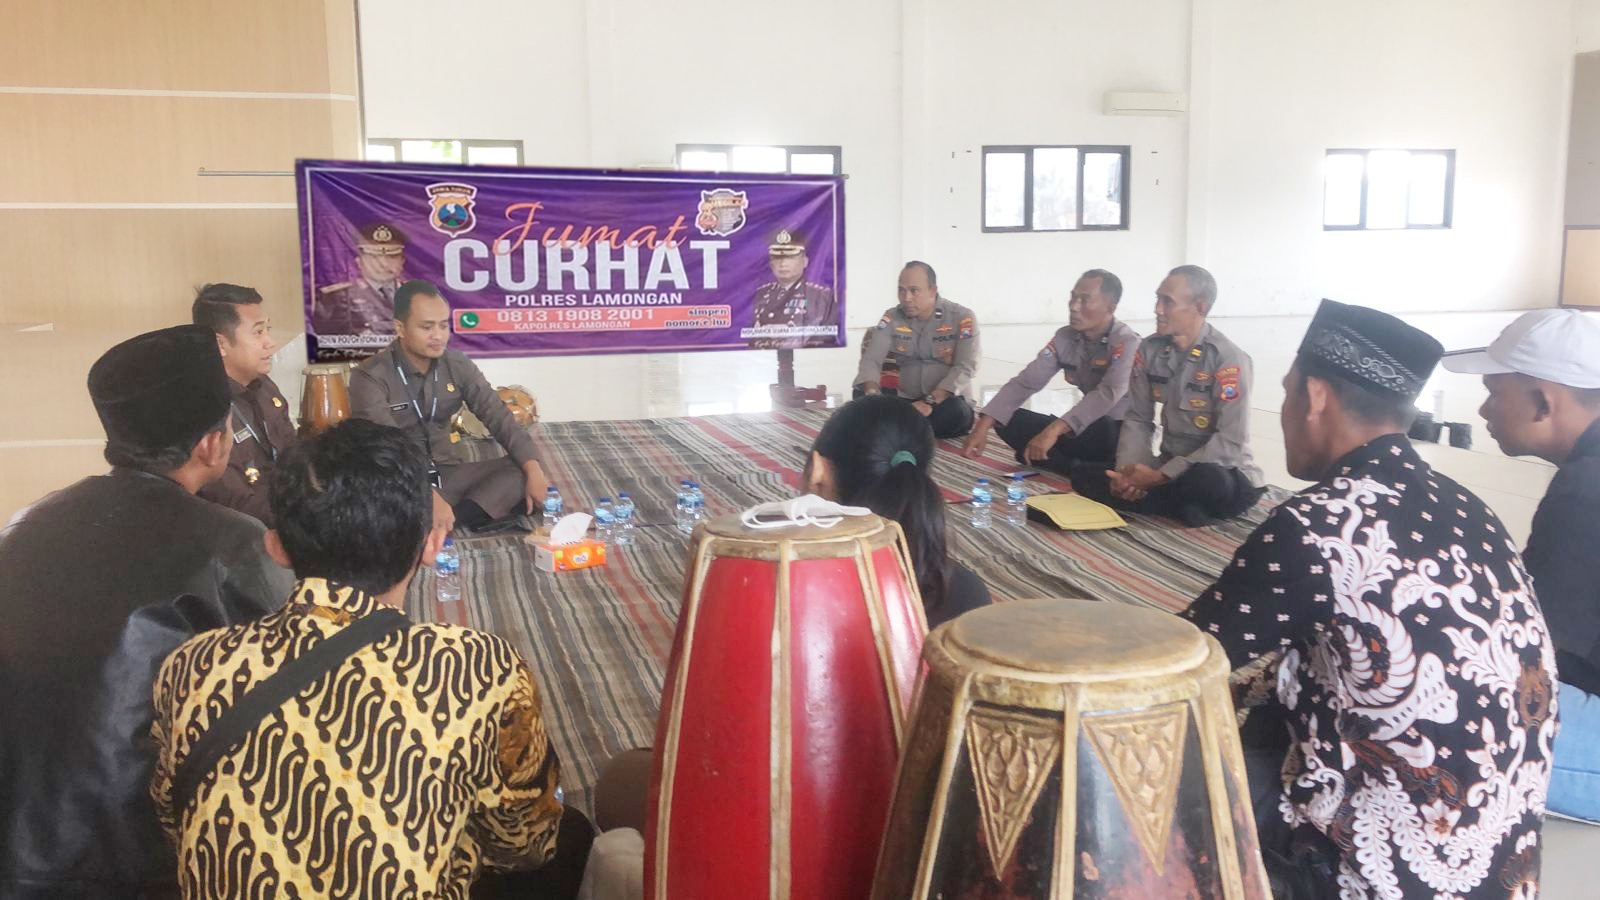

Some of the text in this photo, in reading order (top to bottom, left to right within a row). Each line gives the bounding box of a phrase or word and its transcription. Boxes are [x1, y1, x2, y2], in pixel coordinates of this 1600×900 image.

[493, 202, 688, 256] Jumat
[444, 239, 731, 292] CURHAT
[505, 292, 683, 307] POLRES LAMONGAN
[497, 308, 654, 323] 0813 1908 2001
[688, 307, 727, 317] simpen
[514, 321, 631, 331] KAPOLRES LAMONGAN
